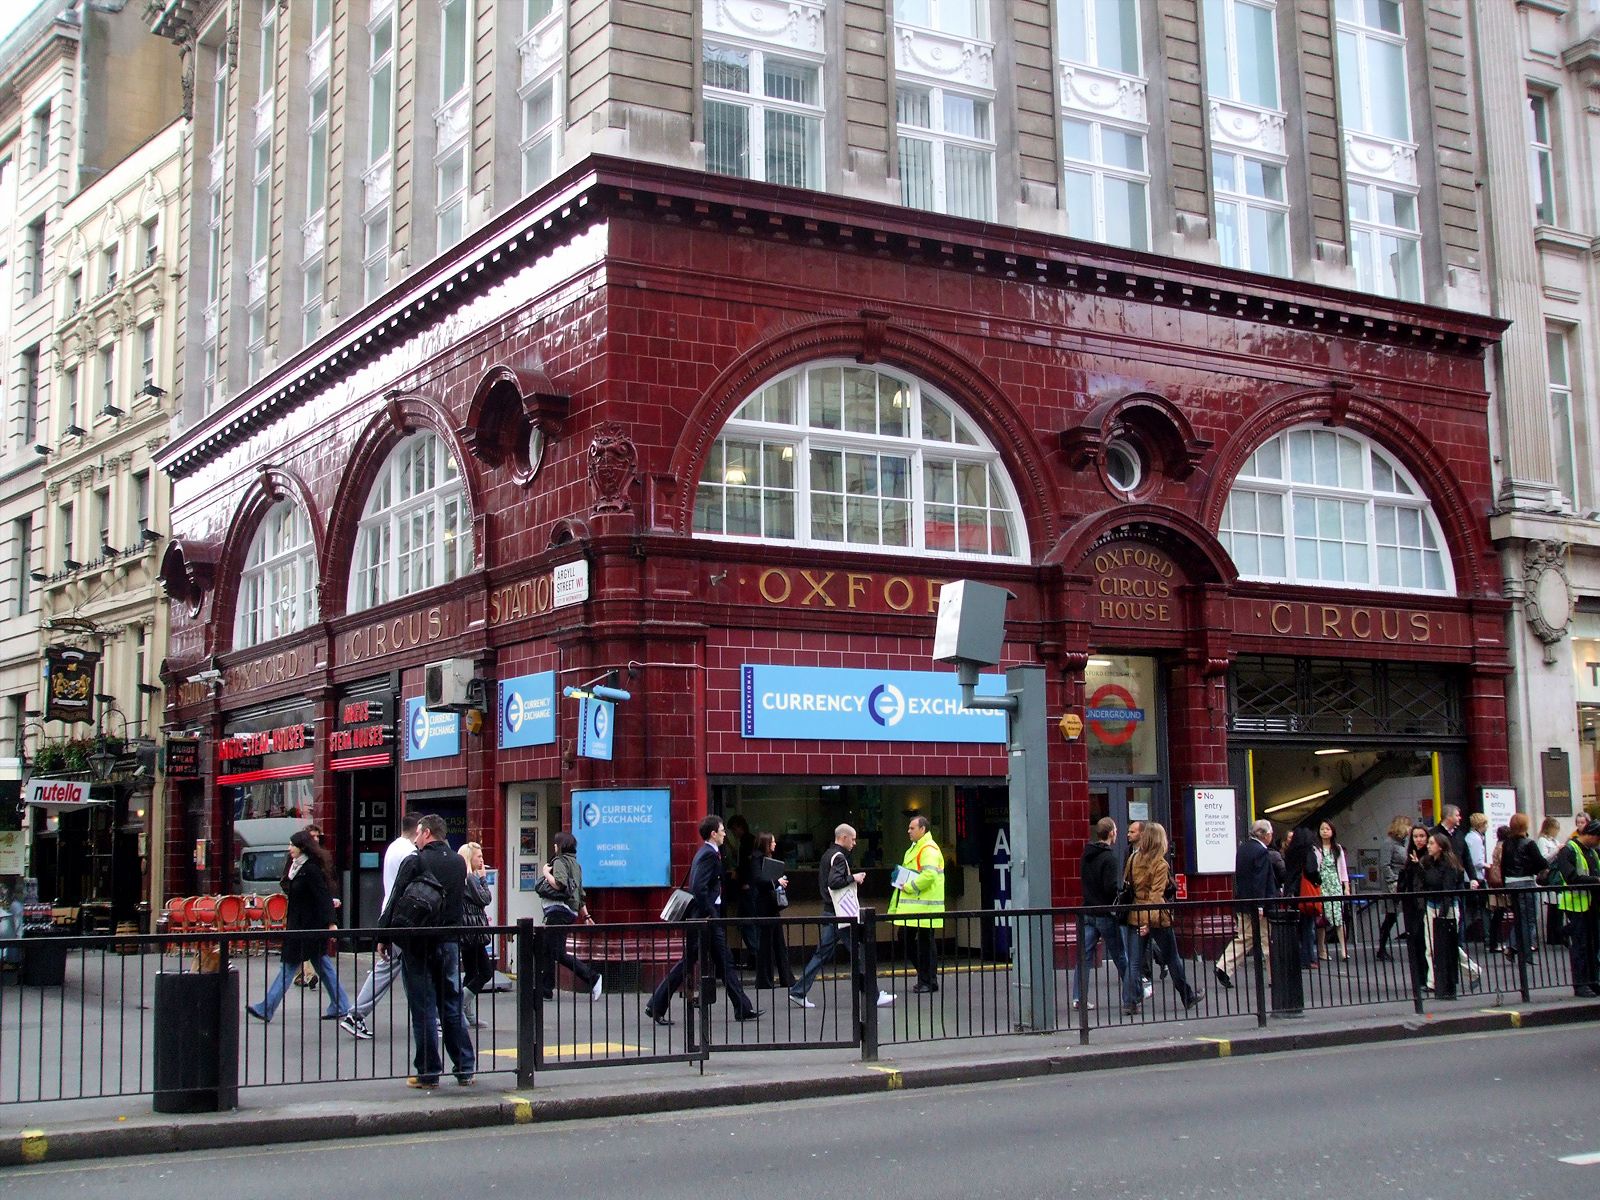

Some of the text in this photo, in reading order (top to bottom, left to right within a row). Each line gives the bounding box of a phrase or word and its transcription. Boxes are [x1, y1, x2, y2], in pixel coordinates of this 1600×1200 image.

[1095, 548, 1174, 578] OXFORD
[557, 567, 575, 580] ARGYLL
[557, 577, 583, 593] STREET W1
[1100, 577, 1170, 598] CIRCUS
[489, 574, 554, 624] STATIO
[1100, 600, 1171, 622] HOUSE
[1271, 602, 1431, 642] CIRCUS
[351, 606, 443, 660] CIRCUS
[524, 698, 551, 710] CURRENCY
[762, 692, 865, 712] CURRENCY
[524, 708, 551, 721] EXCHANGE
[430, 724, 455, 737] EXCHANGE
[34, 782, 82, 802] nutella
[602, 805, 653, 813] CURRENCY
[1204, 802, 1222, 810] entry
[602, 815, 653, 824] EXCHANGE
[597, 843, 630, 851] WECHSEL
[993, 828, 1012, 926] ATM
